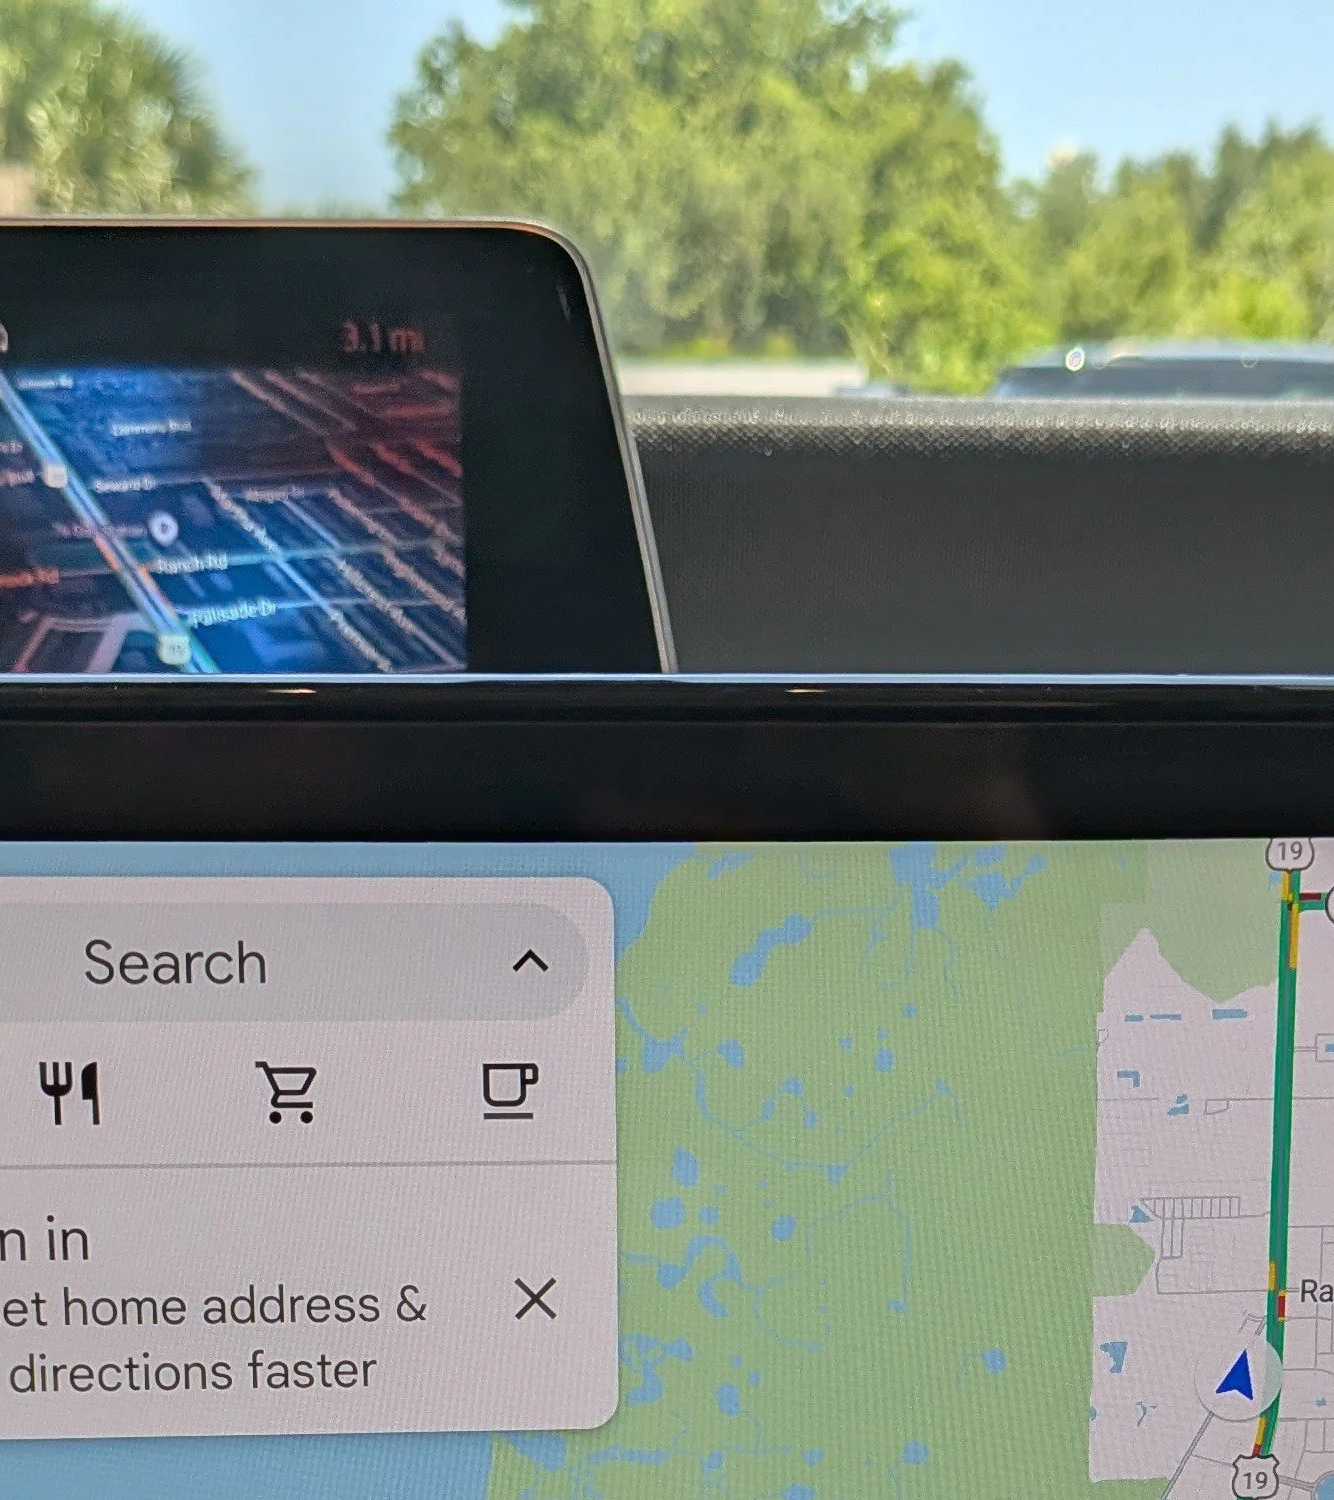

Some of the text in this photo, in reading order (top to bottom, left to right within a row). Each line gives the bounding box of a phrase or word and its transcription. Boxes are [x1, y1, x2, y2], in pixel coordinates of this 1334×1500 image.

[1277, 842, 1303, 862] 19
[83, 938, 268, 986] Search
[47, 1214, 90, 1262] in
[62, 1286, 188, 1327] home
[202, 1284, 381, 1325] address
[395, 1284, 428, 1322] &
[8, 1352, 233, 1394] directions
[246, 1350, 378, 1390] faster
[1242, 1470, 1268, 1492] 19
